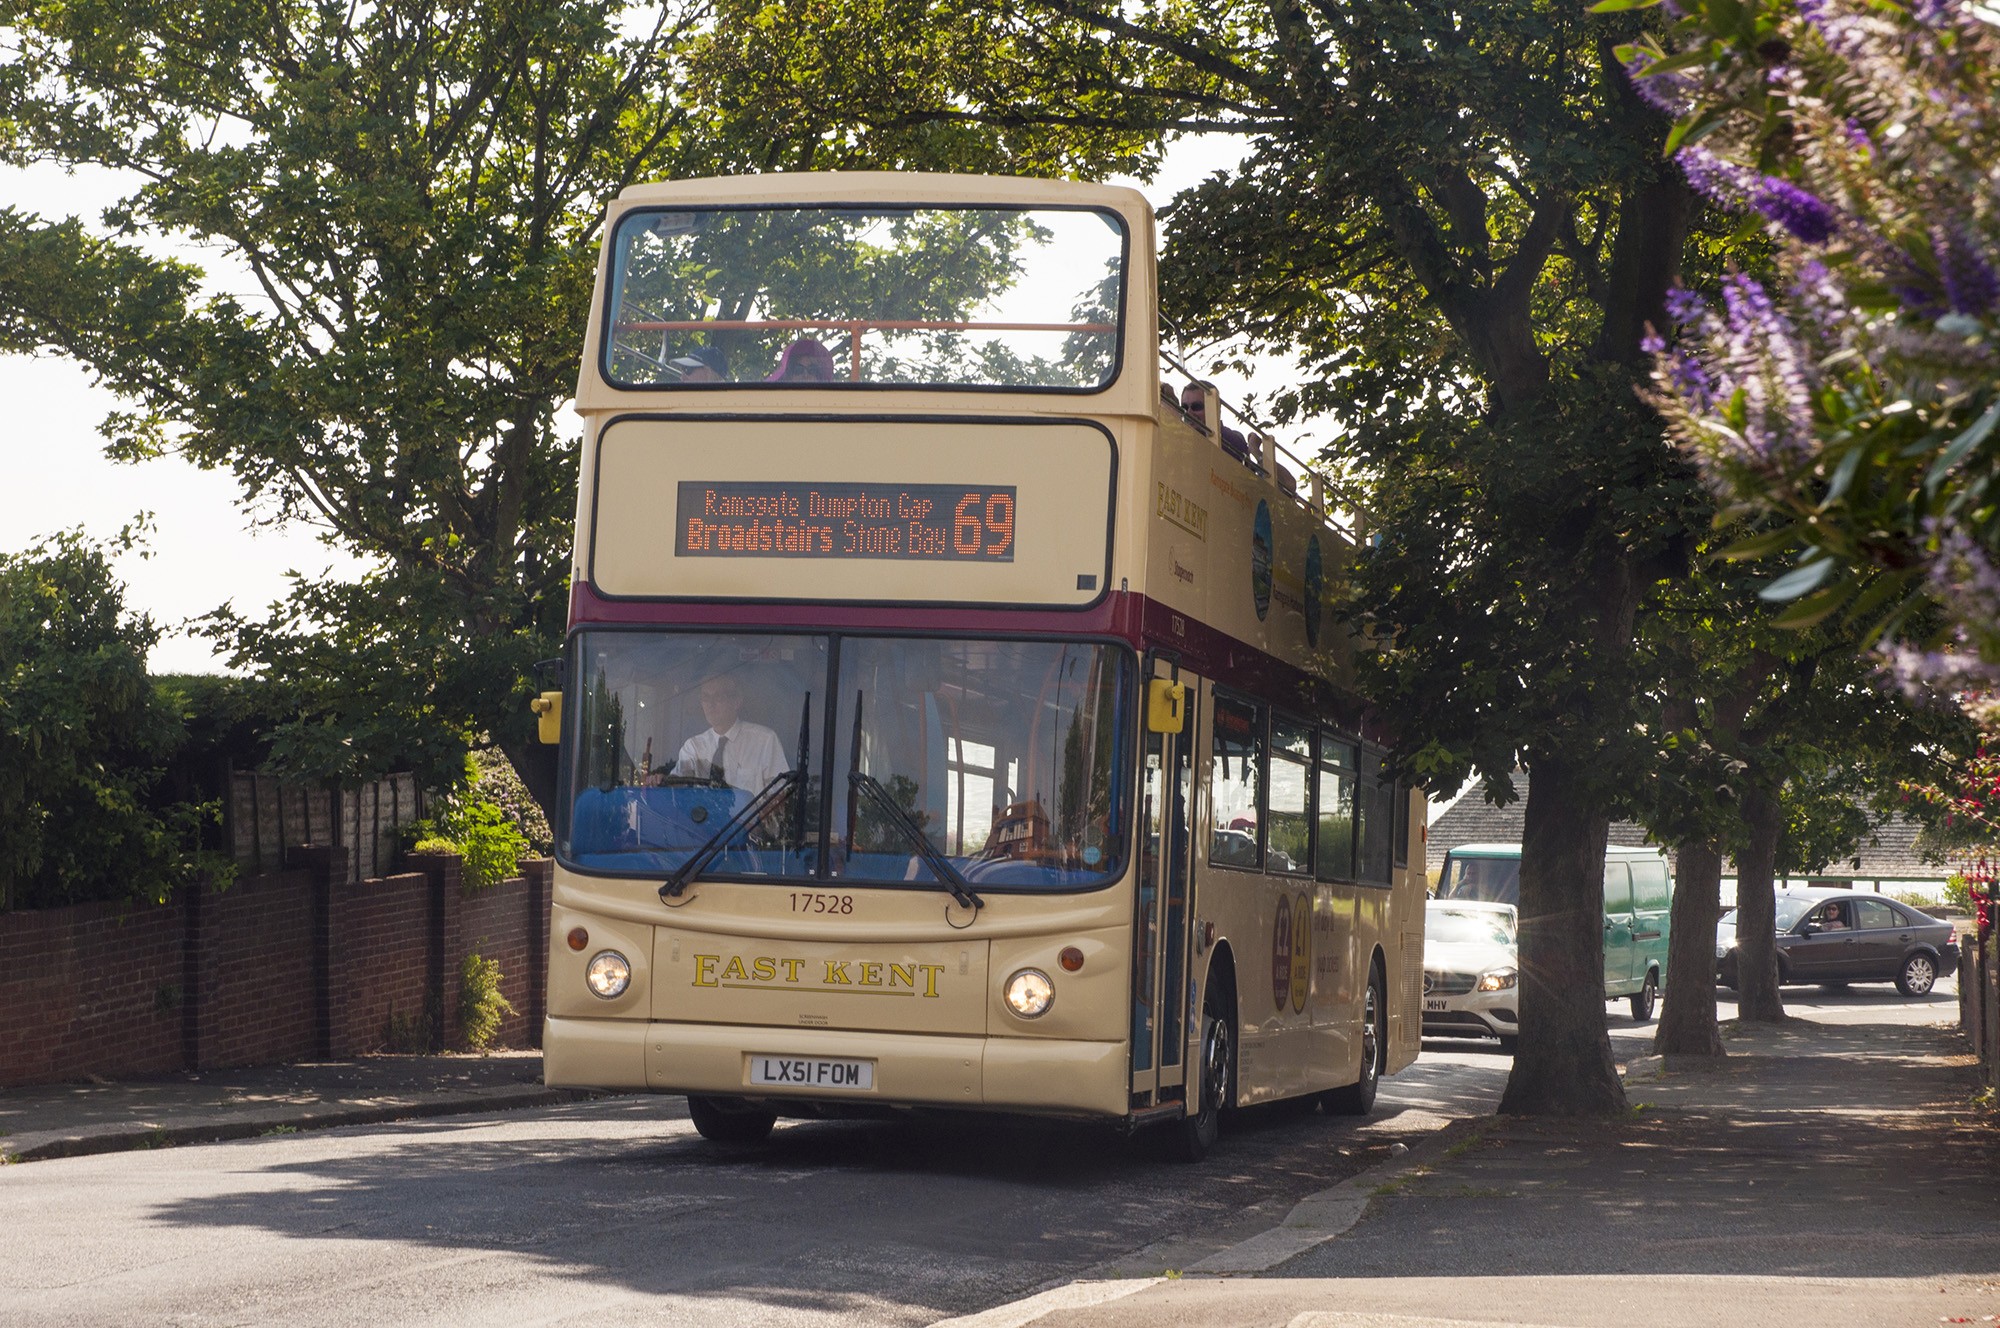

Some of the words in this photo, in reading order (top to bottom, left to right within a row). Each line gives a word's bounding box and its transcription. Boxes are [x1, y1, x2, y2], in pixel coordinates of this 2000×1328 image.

[705, 490, 800, 517] Ramsgate
[810, 491, 891, 518] Dumpton
[898, 493, 933, 519] Gap
[1157, 481, 1181, 518] EAST
[1182, 496, 1208, 543] KENT
[687, 518, 833, 552] Broadstairs
[843, 520, 901, 553] Stone
[908, 521, 946, 554] Bay
[953, 493, 1015, 555] 69
[789, 893, 854, 915] 17528
[692, 954, 806, 988] EAST
[823, 960, 945, 998] KENT
[1427, 1000, 1447, 1010] MHV
[763, 1059, 812, 1083] LX51
[817, 1063, 860, 1085] FOM
